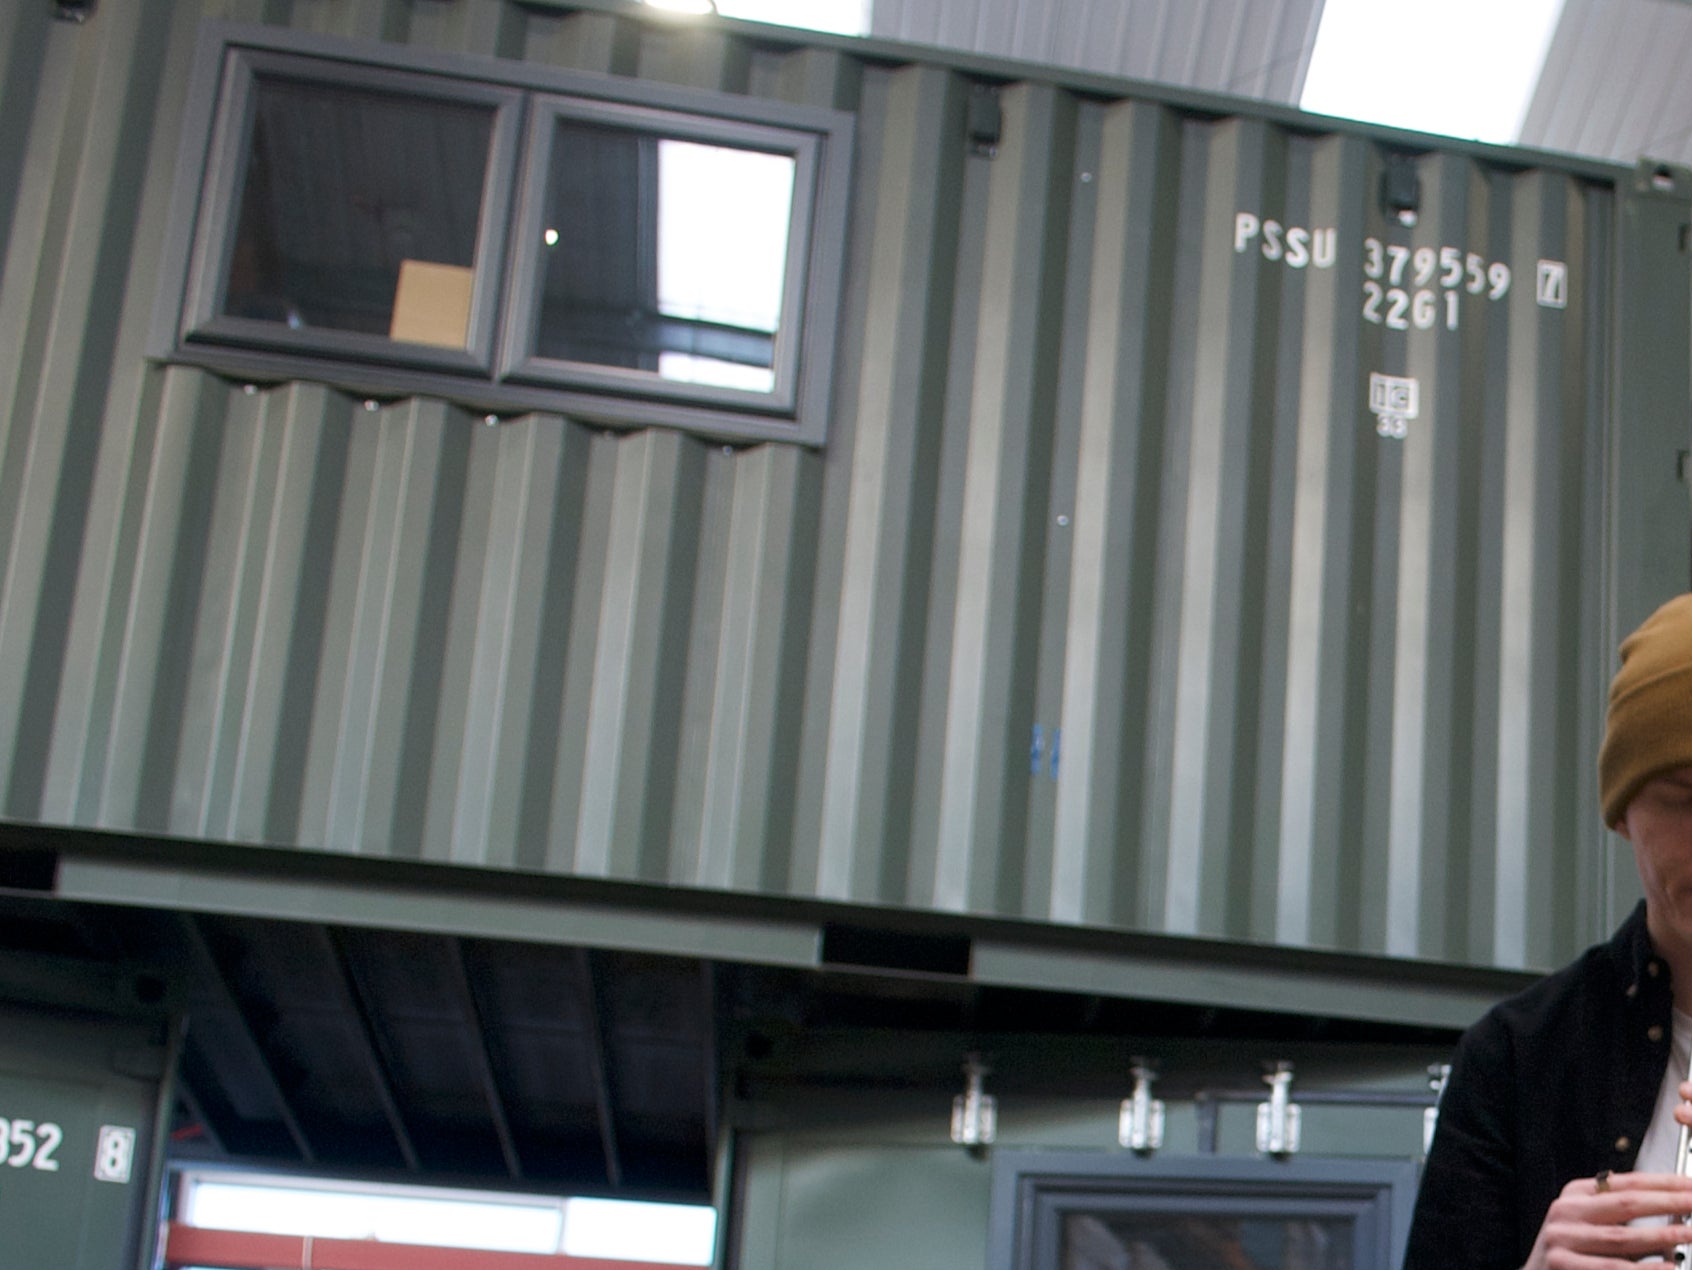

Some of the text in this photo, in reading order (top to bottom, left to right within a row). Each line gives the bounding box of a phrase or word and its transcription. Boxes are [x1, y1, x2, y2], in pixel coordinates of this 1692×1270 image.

[1235, 213, 1565, 305] PSSU 379559 7
[1363, 281, 1459, 330] 22G1
[101, 1128, 131, 1180] 8
